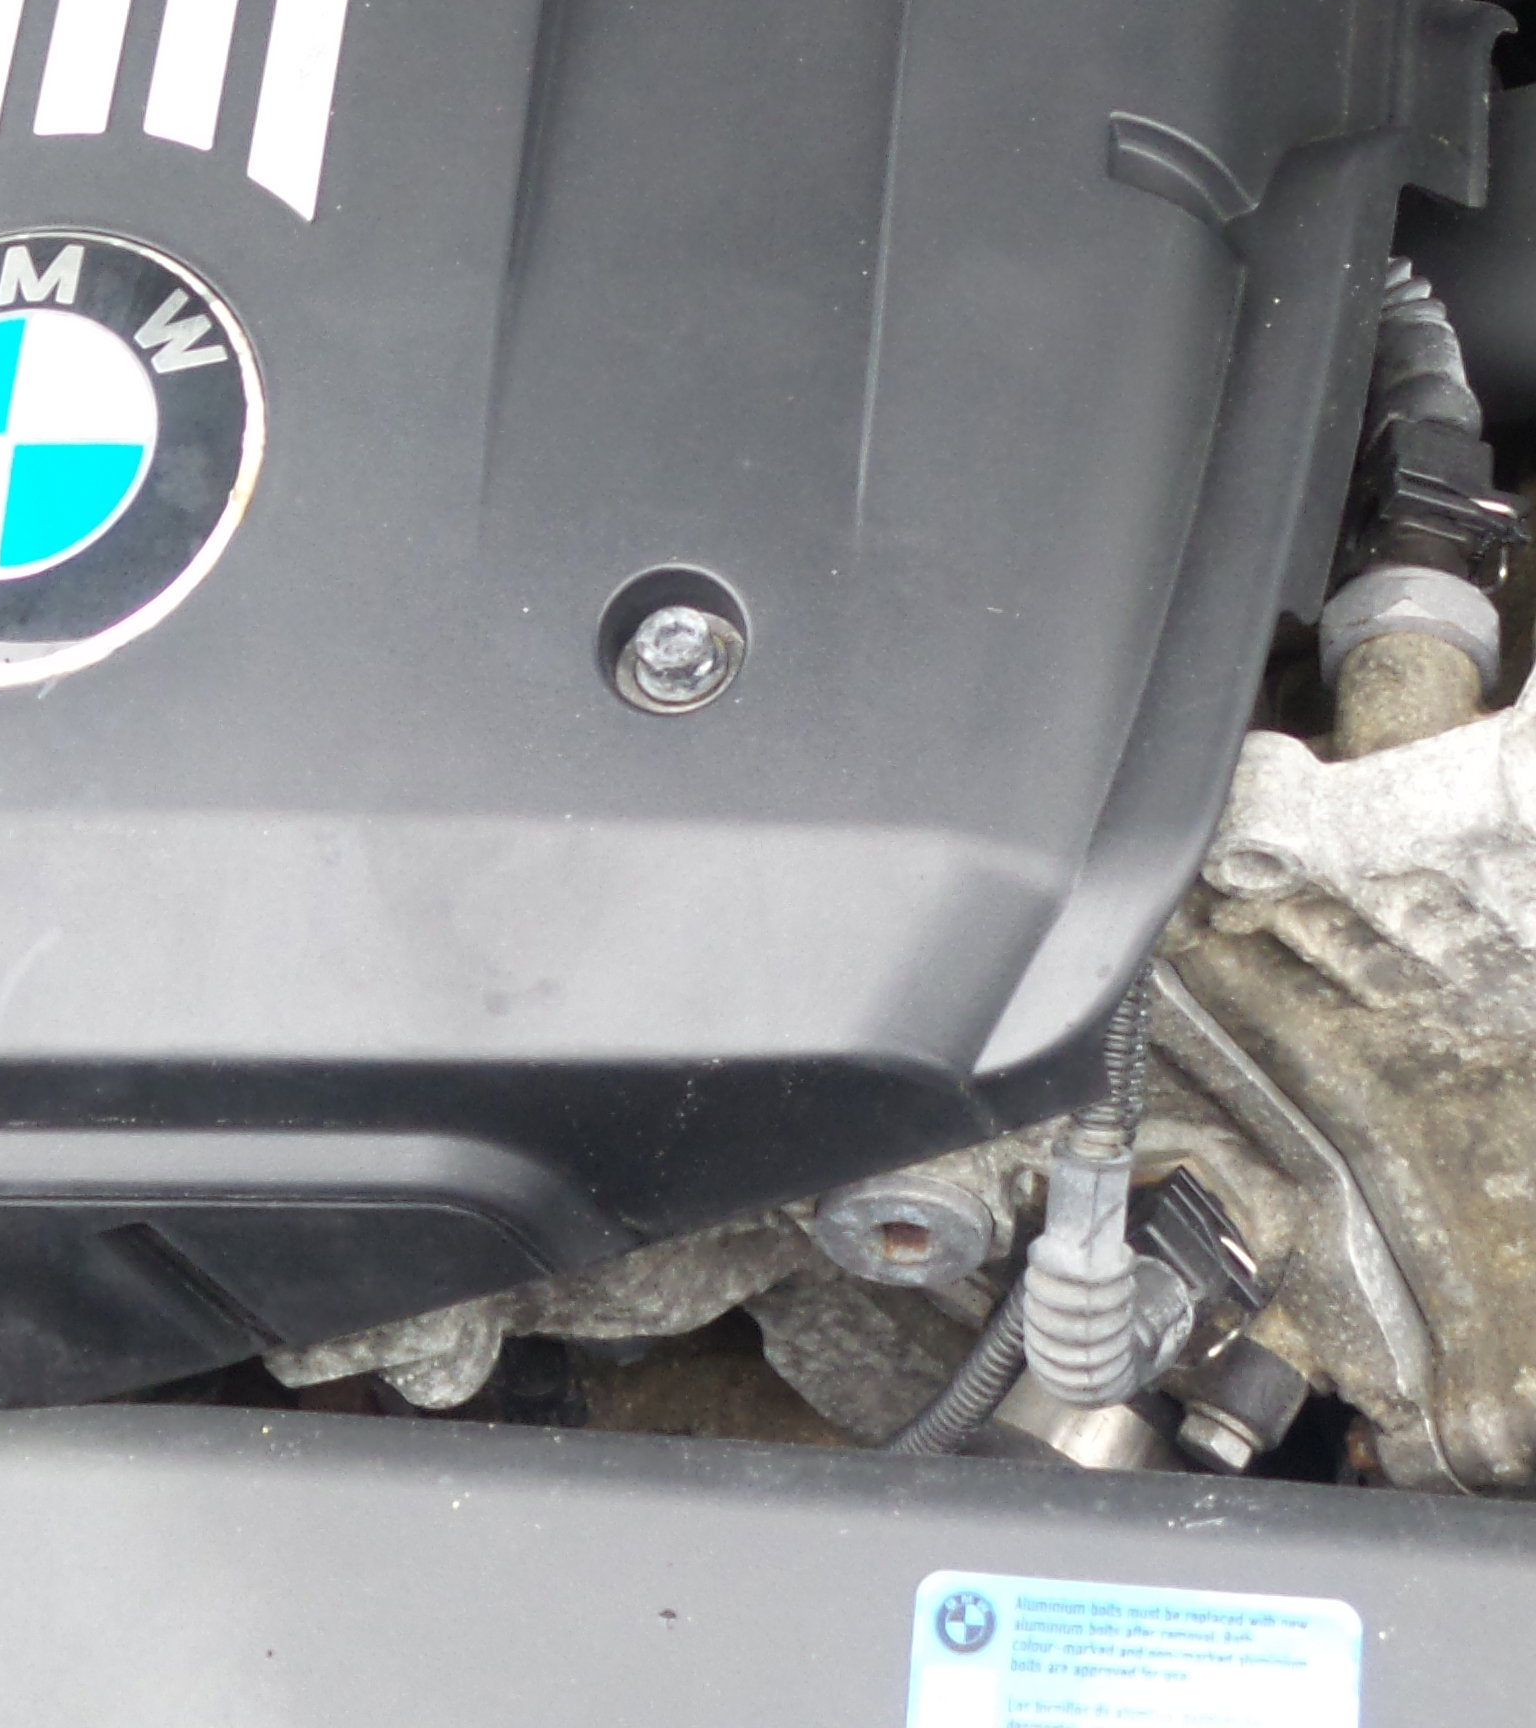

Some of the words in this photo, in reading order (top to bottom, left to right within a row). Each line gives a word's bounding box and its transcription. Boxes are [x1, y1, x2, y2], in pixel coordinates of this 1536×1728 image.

[1015, 1596, 1085, 1615] Aluminium
[1091, 1600, 1122, 1617] bolts
[1128, 1607, 1160, 1619] must
[1165, 1607, 1180, 1621] be
[1185, 1609, 1243, 1626] replaced
[1249, 1613, 1275, 1627] with
[1014, 1617, 1083, 1635] aluminium
[1089, 1622, 1120, 1637] bolts
[1011, 1655, 1042, 1672] bolts
[1048, 1663, 1069, 1674] are
